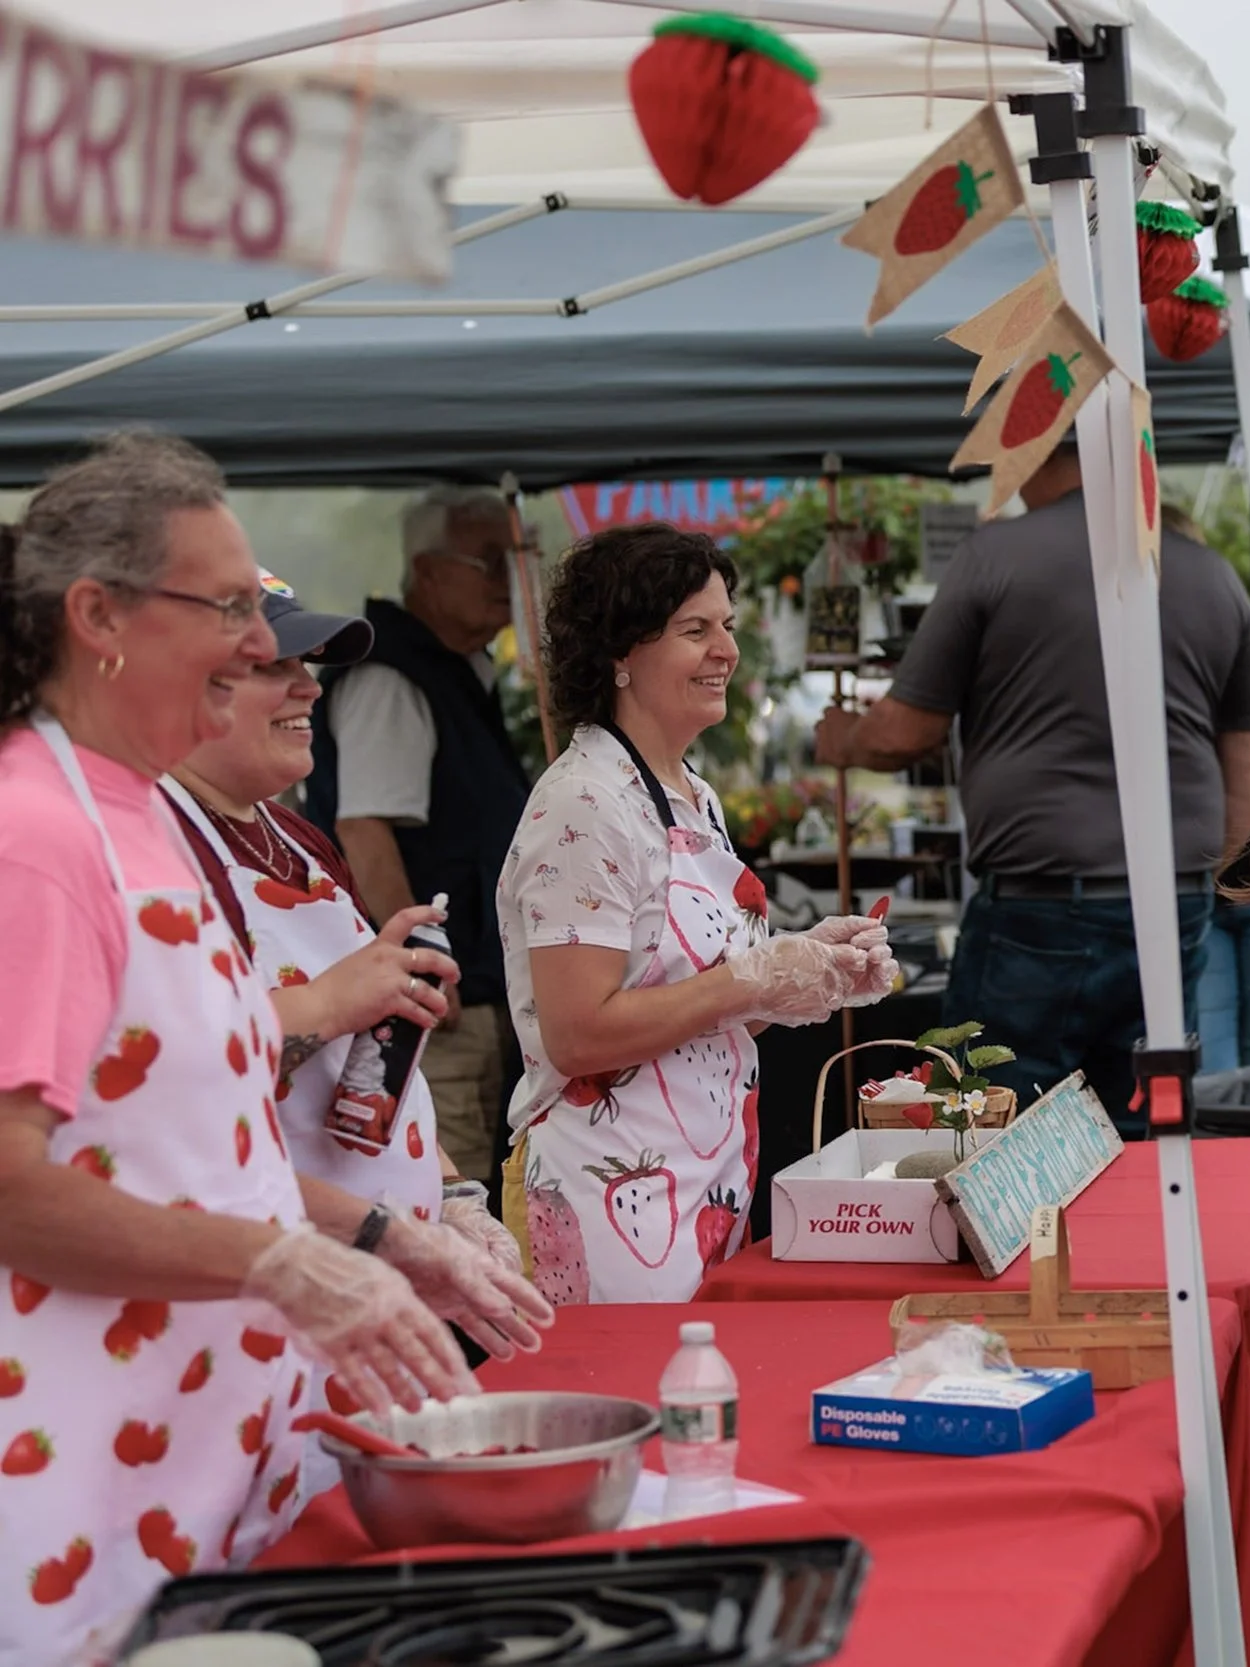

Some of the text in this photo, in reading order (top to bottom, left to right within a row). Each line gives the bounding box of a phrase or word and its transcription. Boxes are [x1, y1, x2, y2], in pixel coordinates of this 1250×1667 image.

[0, 14, 293, 261] RRIES
[956, 1088, 1110, 1260] REFRESHMENTS
[836, 1203, 882, 1217] PICK
[809, 1219, 915, 1235] YOUR OWN
[821, 1405, 907, 1426] Disposable
[846, 1424, 900, 1442] Gloves
